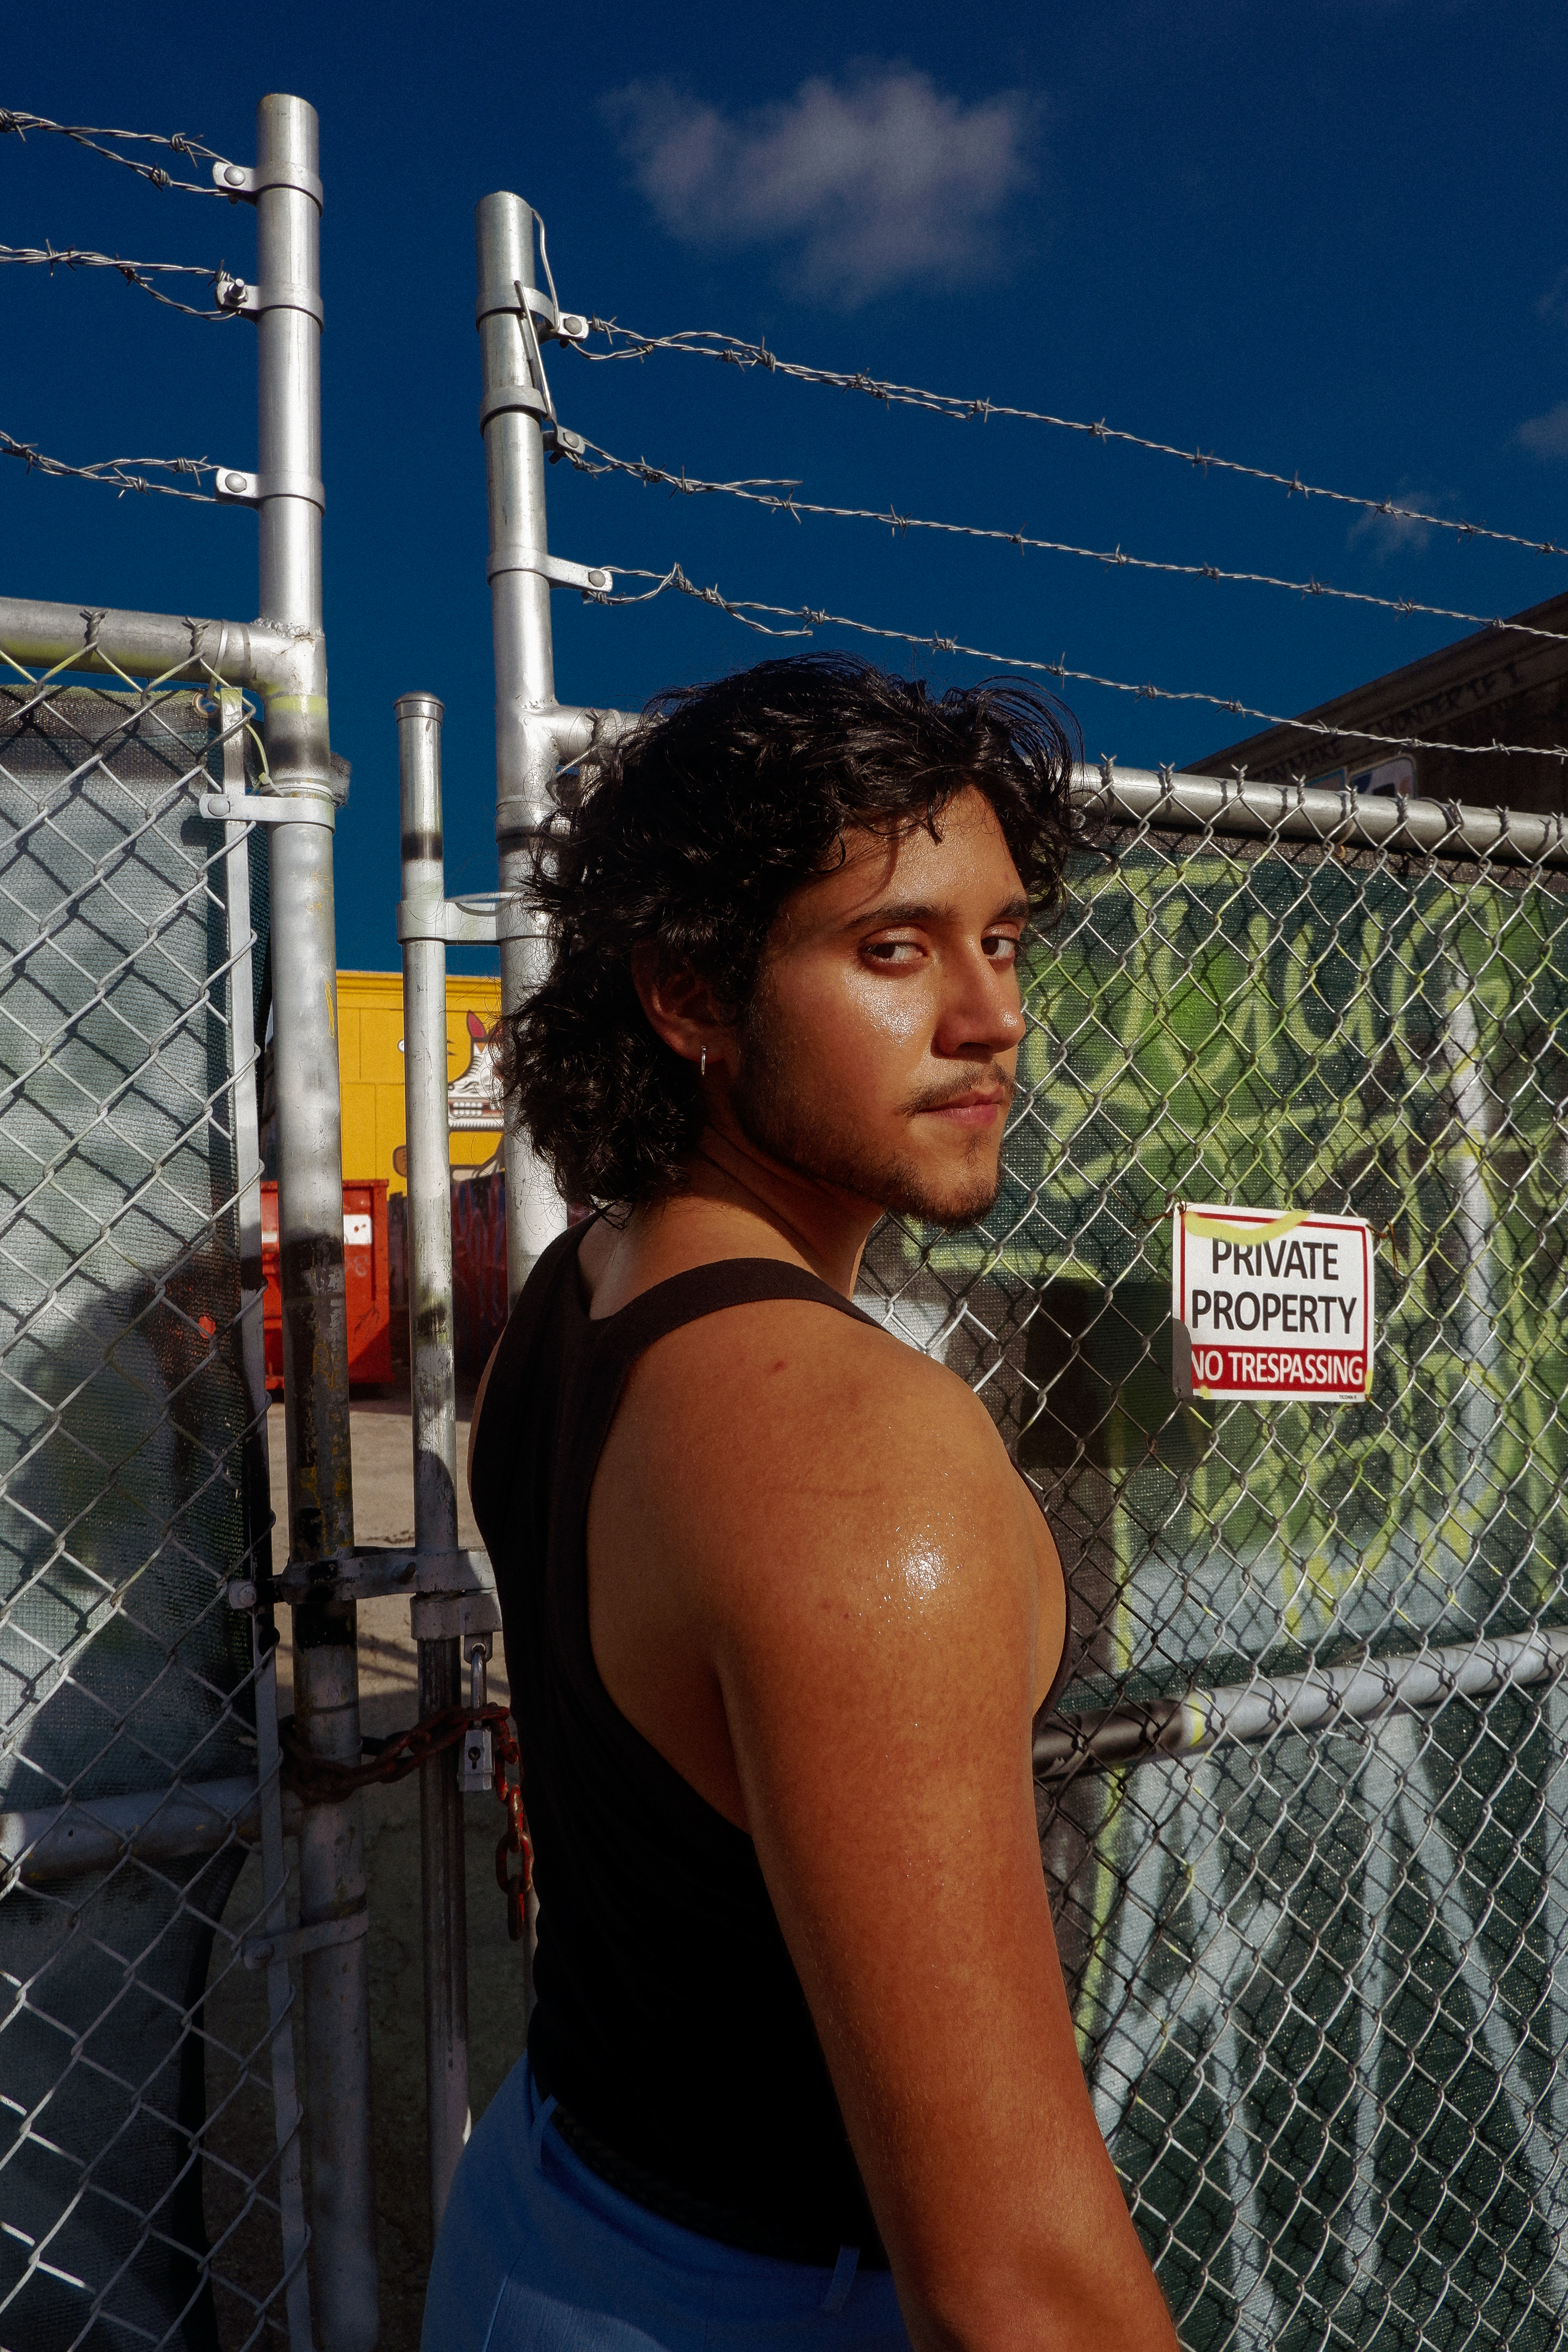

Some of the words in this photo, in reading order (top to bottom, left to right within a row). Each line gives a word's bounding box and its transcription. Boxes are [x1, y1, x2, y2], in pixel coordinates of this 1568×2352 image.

[1212, 1237, 1339, 1280] PRIVATE
[1192, 1289, 1357, 1334] PROPERTY
[1191, 1350, 1223, 1381] NO
[1228, 1352, 1363, 1385] TRESPASSING
